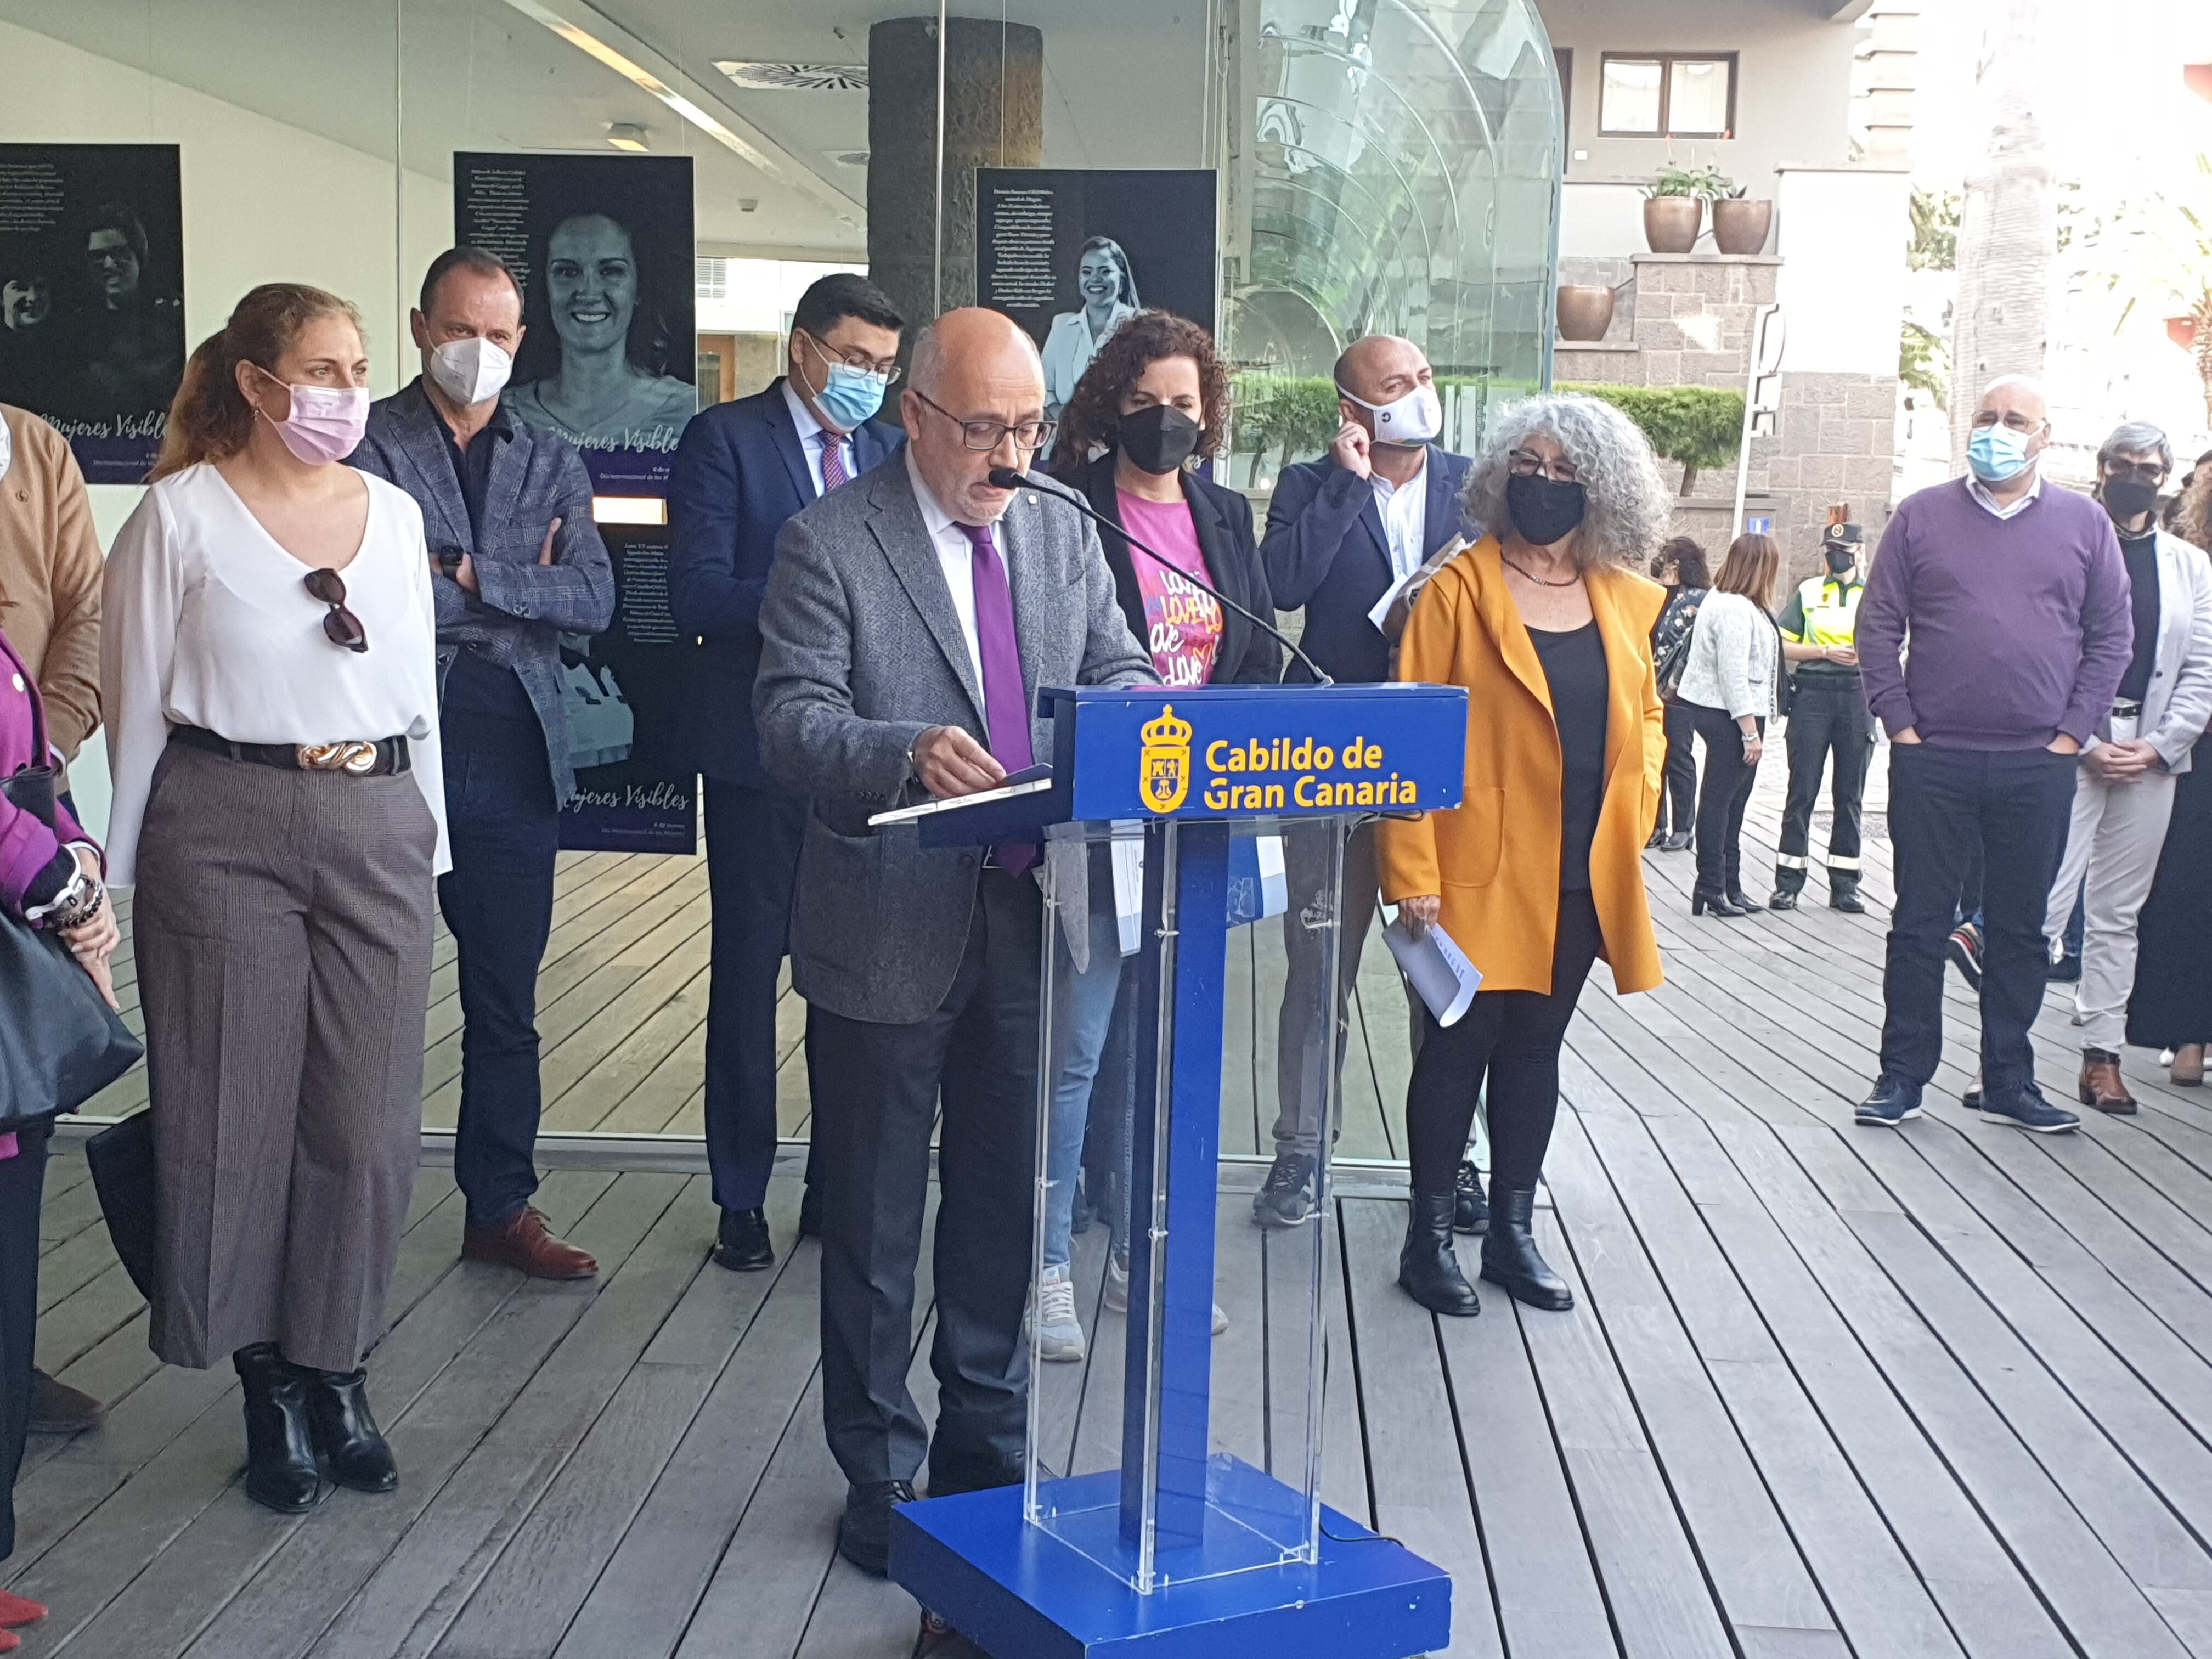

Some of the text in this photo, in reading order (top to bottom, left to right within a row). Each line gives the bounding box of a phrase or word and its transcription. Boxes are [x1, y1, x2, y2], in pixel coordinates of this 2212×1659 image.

[116, 410, 168, 441] Visibl
[624, 425, 679, 454] Visible
[1206, 736, 1383, 772] Cabildo de
[563, 781, 689, 814] ujeres Visibles
[1204, 772, 1417, 810] Gran Canaria
